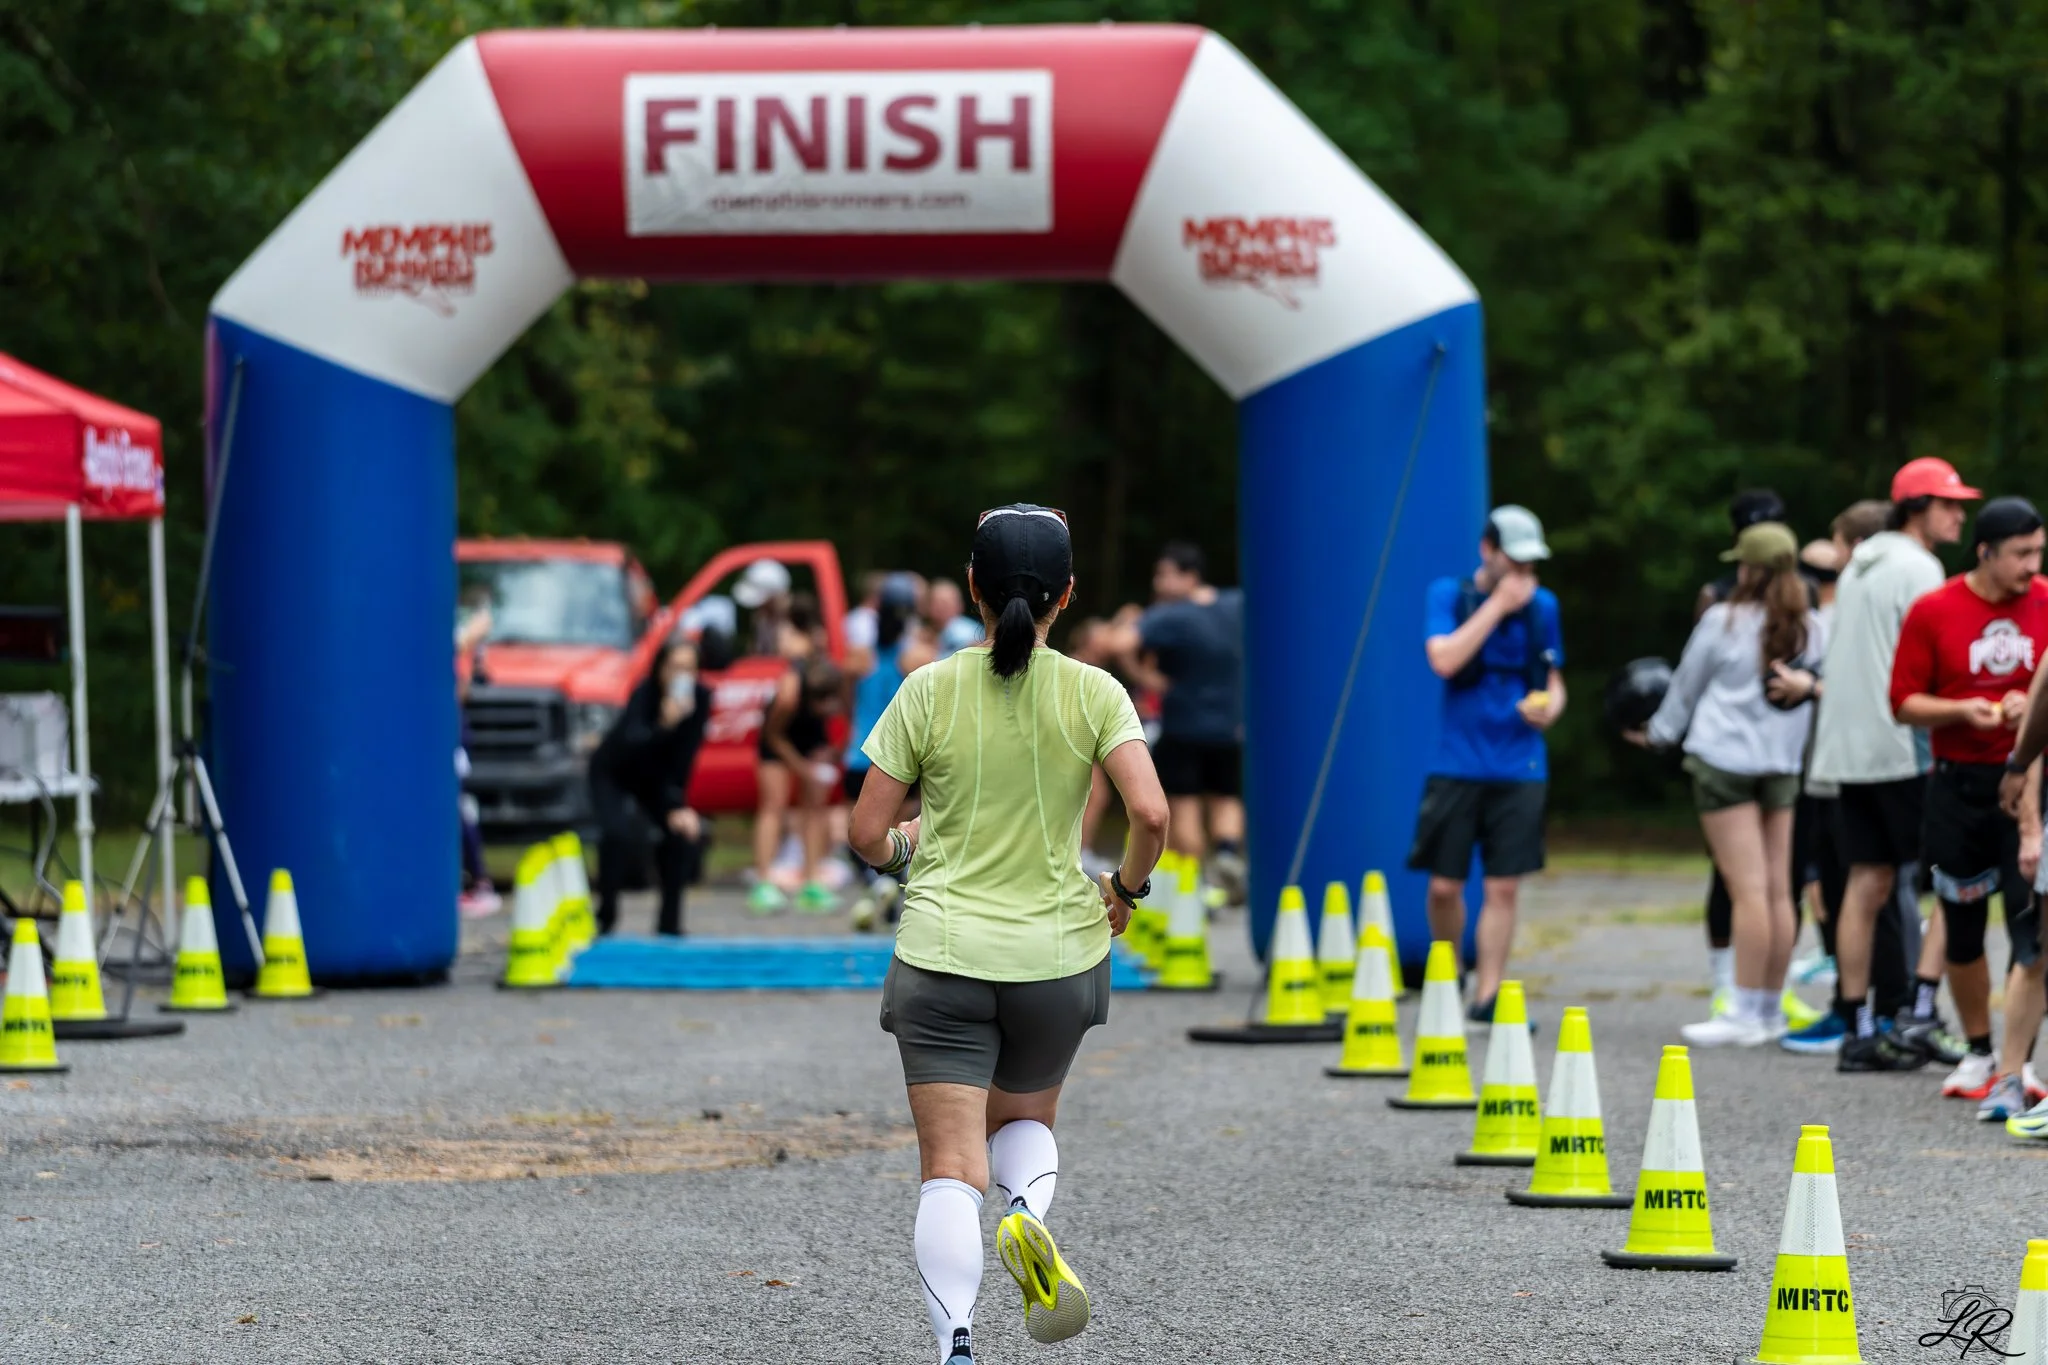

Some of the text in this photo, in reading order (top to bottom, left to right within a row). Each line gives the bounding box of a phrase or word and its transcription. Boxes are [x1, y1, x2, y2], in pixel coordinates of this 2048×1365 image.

[644, 95, 1032, 174] FINISH
[1482, 1098, 1537, 1117] MRTC
[1550, 1135, 1605, 1154] MRTC
[1644, 1189, 1706, 1210] MRTC
[1777, 1287, 1849, 1313] MRTC
